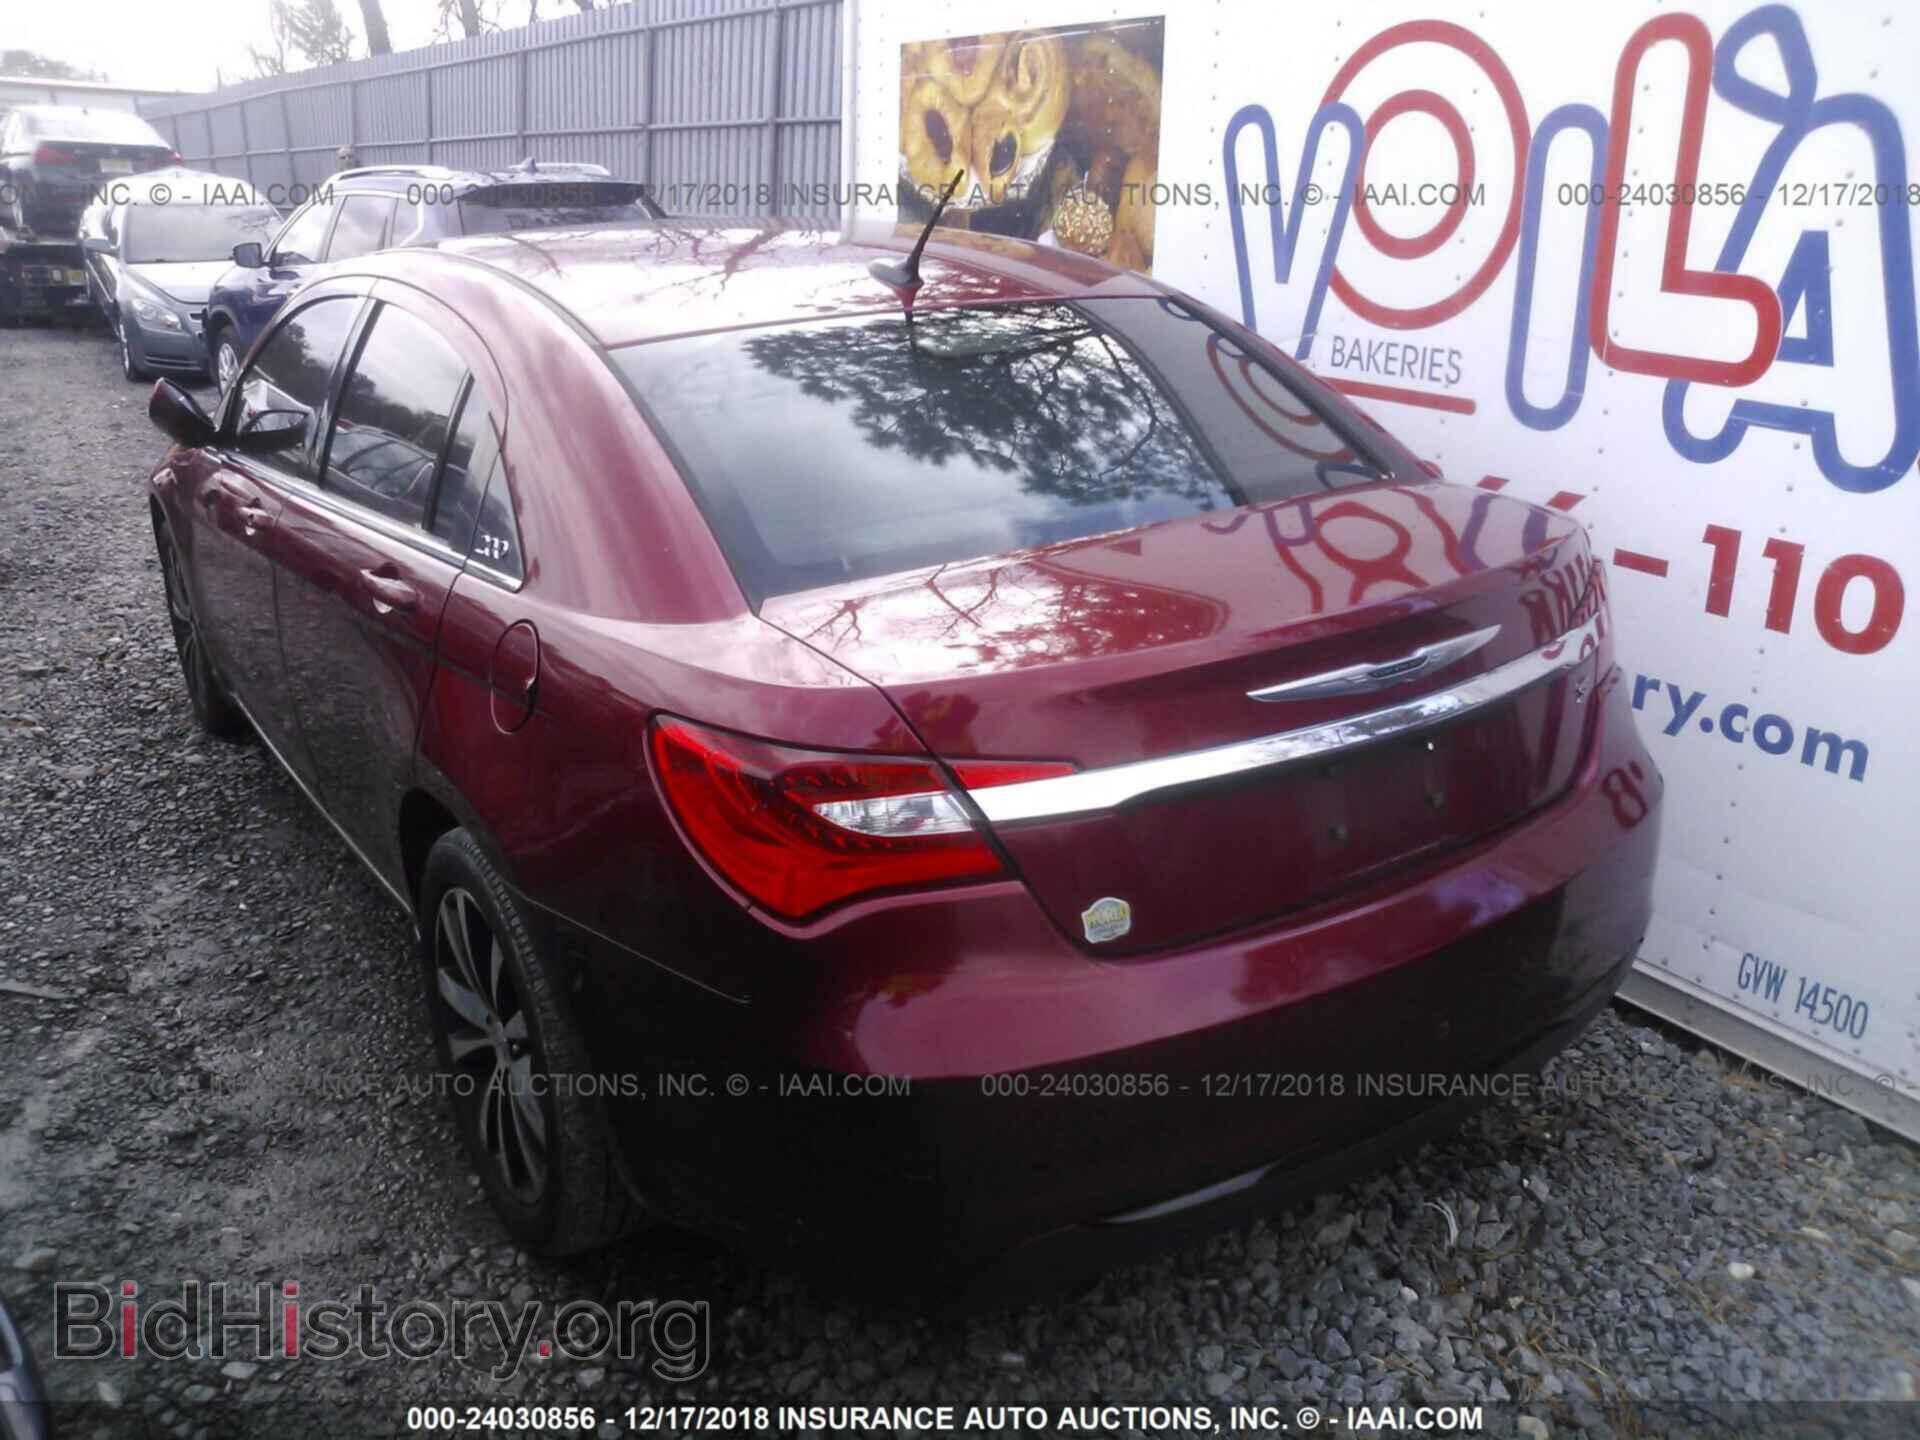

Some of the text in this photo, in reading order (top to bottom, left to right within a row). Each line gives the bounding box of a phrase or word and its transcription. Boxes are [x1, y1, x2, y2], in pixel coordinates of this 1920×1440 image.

[1331, 335, 1462, 384] BAKERIES
[1738, 953, 1868, 1039] GVW 14500
